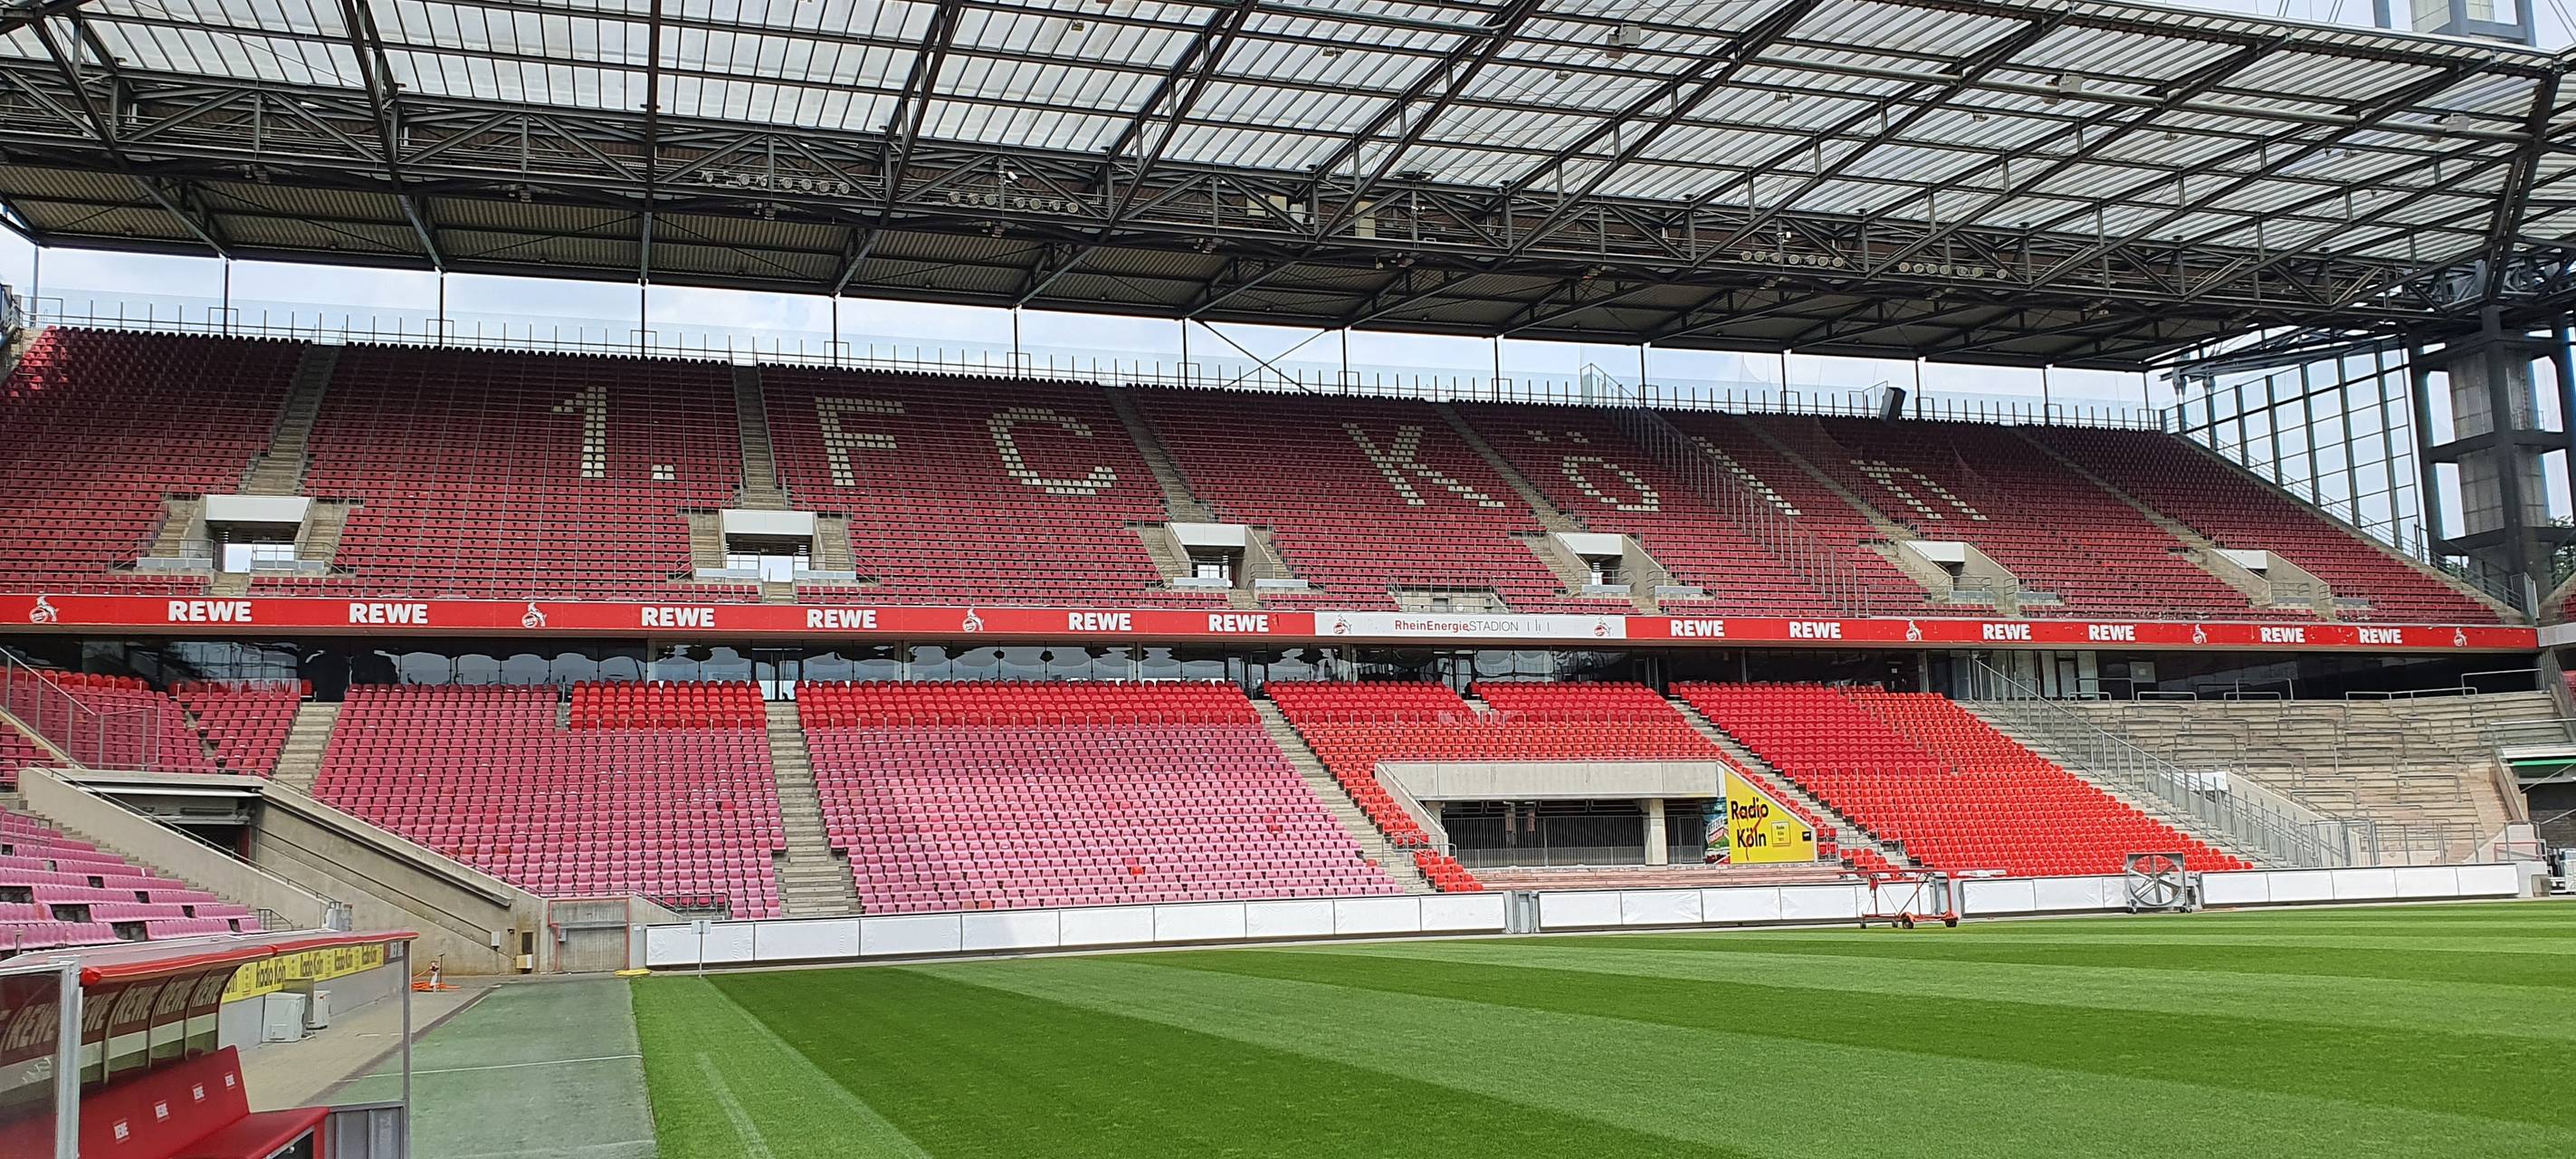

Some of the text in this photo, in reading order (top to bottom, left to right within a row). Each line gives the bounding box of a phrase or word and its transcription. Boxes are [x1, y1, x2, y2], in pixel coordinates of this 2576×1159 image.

[168, 600, 253, 622] REWE
[348, 603, 428, 624] REWE
[641, 607, 715, 627] REWE
[806, 608, 877, 629] REWE
[1068, 612, 1132, 631] REWE
[1208, 614, 1269, 633] REWE
[1670, 619, 1724, 637] REWE
[1789, 621, 1842, 639] REWE
[1982, 623, 2032, 641] REWE
[2087, 624, 2135, 642] REWE
[2260, 627, 2305, 644] REWE
[2359, 627, 2402, 645] REWE
[1731, 797, 1769, 819] Radio
[1737, 828, 1767, 848] Köln
